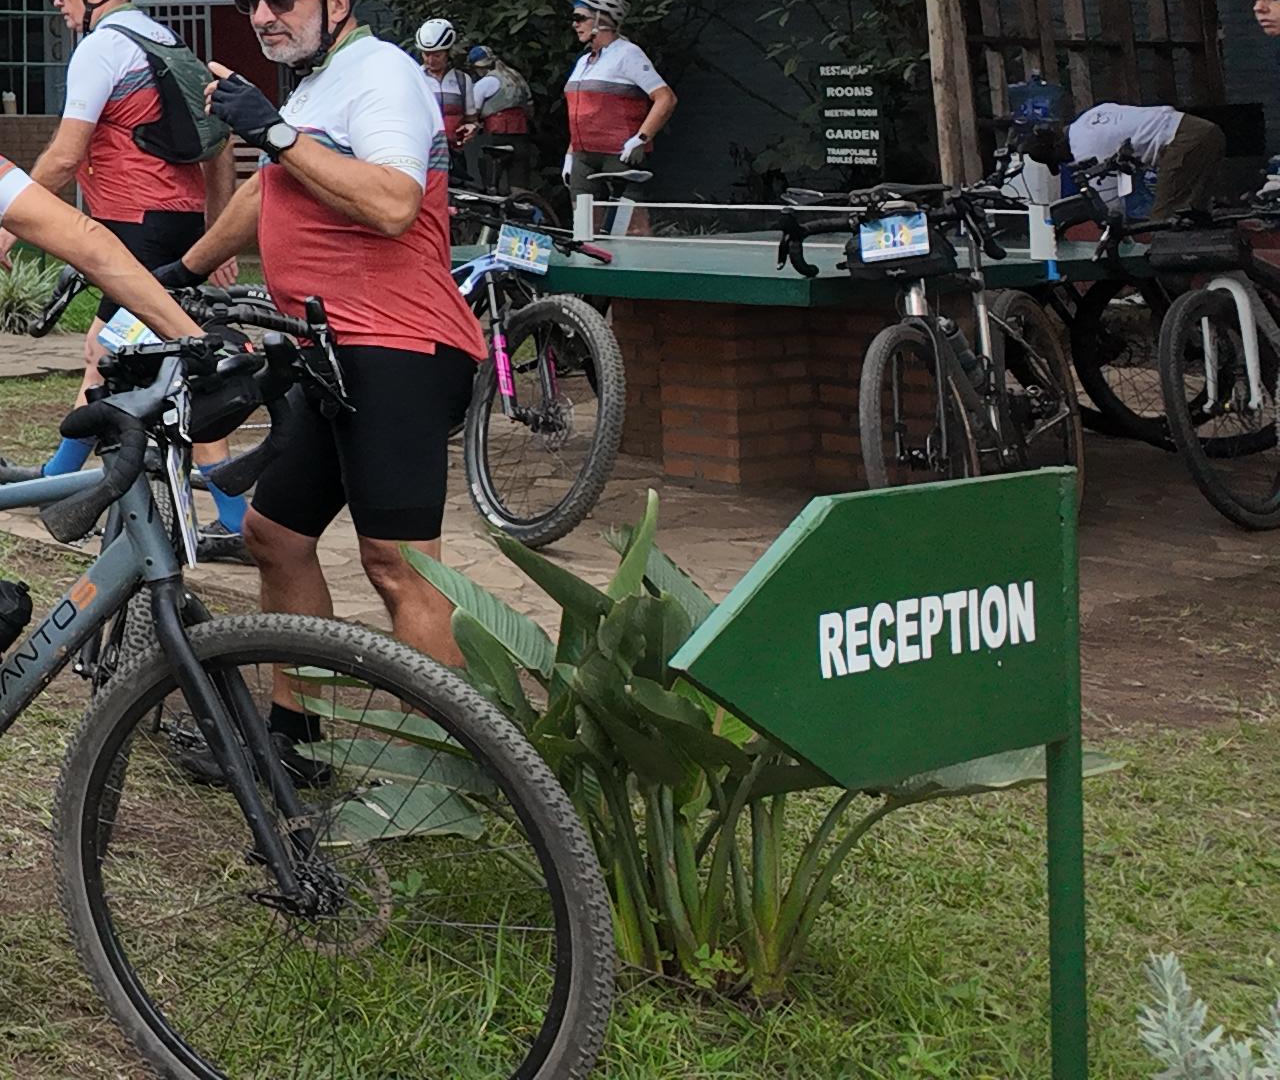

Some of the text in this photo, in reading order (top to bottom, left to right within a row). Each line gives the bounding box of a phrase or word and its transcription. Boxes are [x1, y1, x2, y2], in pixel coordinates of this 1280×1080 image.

[826, 86, 874, 97] ROOMS
[825, 128, 880, 140] GARDEN
[818, 580, 1037, 680] RECEPTION
